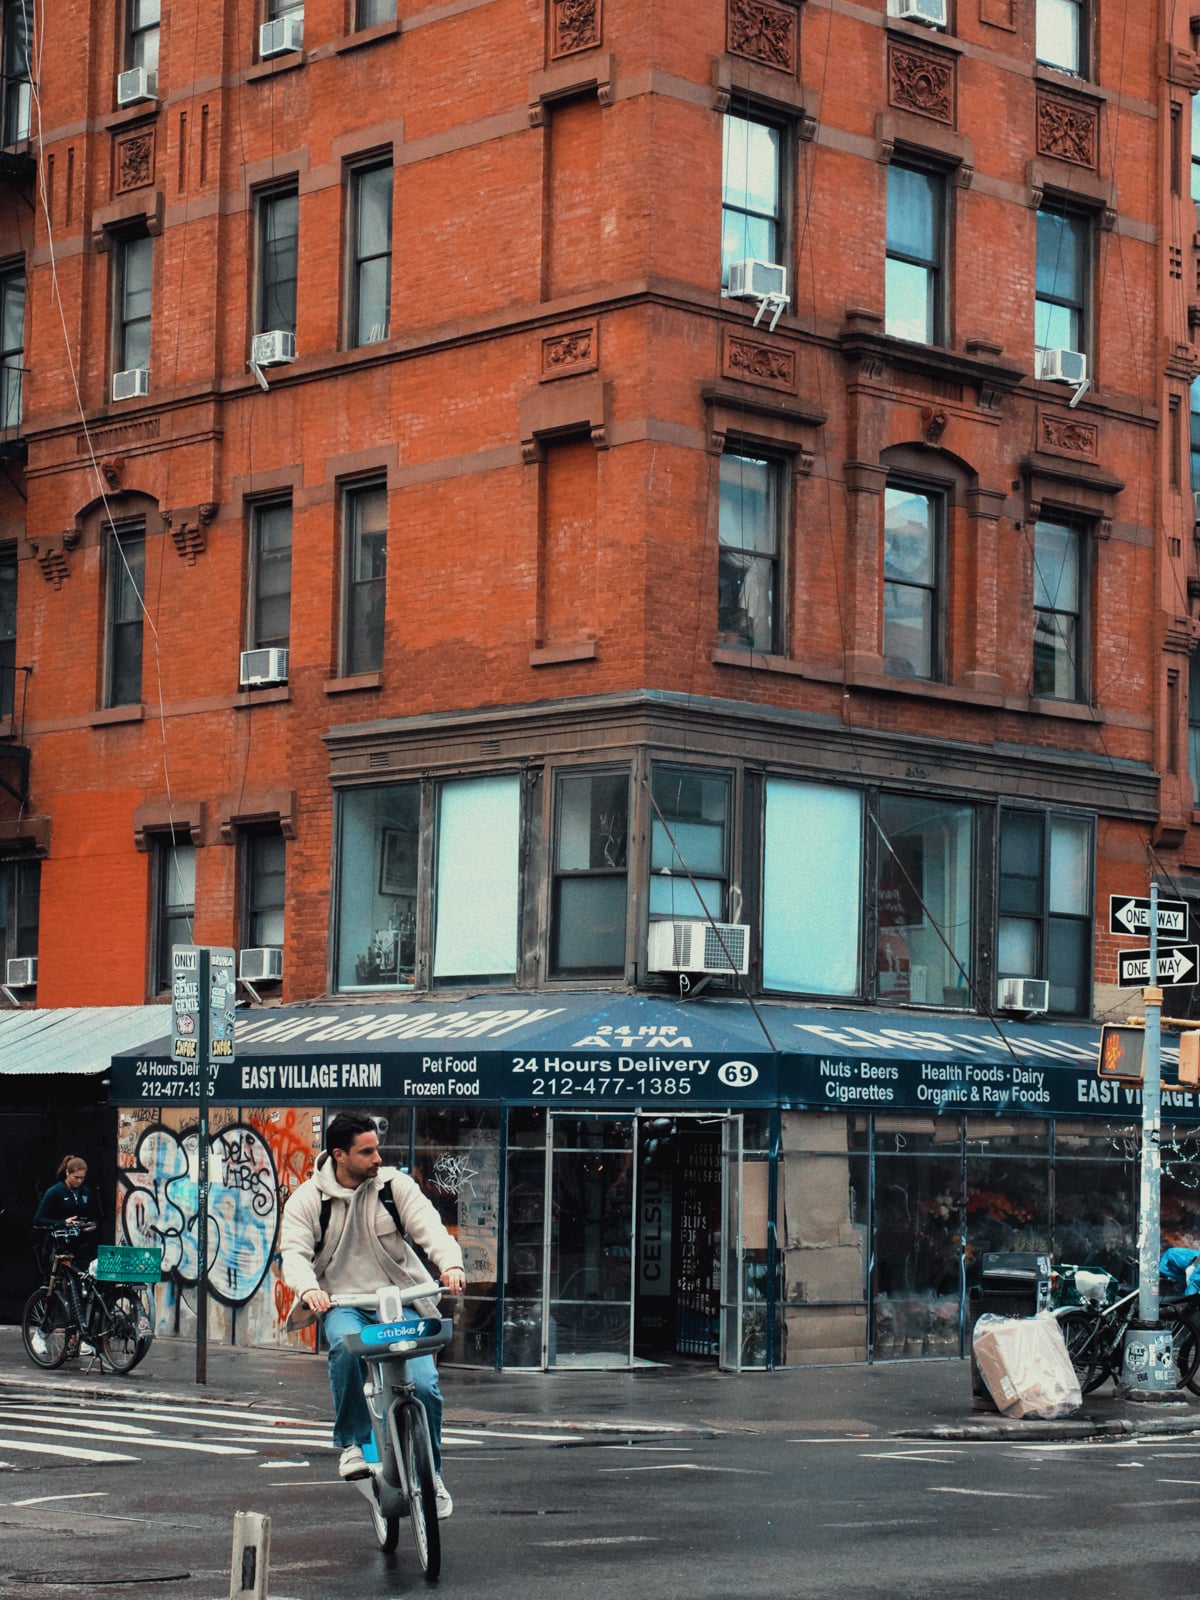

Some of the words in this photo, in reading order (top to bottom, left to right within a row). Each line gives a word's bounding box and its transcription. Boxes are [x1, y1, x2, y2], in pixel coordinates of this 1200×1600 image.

[1126, 909, 1147, 925] ONE
[1157, 911, 1179, 927] WAY
[1127, 961, 1148, 977] ONE
[1158, 958, 1182, 974] WAY
[304, 1007, 566, 1042] GROCERY
[596, 1025, 631, 1036] 24
[638, 1025, 679, 1036] HR
[571, 1036, 694, 1048] ATM
[793, 1023, 986, 1054] EAST
[136, 1061, 148, 1076] 24
[149, 1061, 178, 1076] Hours
[180, 1061, 220, 1079] Deliry
[422, 1056, 443, 1073] Pet
[445, 1056, 477, 1073] Food
[512, 1057, 538, 1073] 24
[545, 1057, 612, 1072] Hours
[618, 1057, 711, 1075] Delivery
[820, 1059, 852, 1078] Nuts
[860, 1062, 899, 1080] Beers
[242, 1066, 276, 1089] EAST
[279, 1064, 338, 1088] VILLAGE
[342, 1063, 382, 1088] FARM
[724, 1065, 753, 1083] 69
[921, 1063, 963, 1081] Health
[965, 1065, 1005, 1081] Foods
[1012, 1067, 1045, 1088] Dairy
[141, 1081, 215, 1097] 212-477-135
[404, 1079, 446, 1095] Frozen
[448, 1079, 480, 1095] Food
[532, 1078, 692, 1095] 212-477-1385
[825, 1081, 894, 1102] Cigarettes
[917, 1084, 968, 1105] Organic
[970, 1085, 980, 1101] &
[982, 1086, 1010, 1102] Raw
[1011, 1086, 1051, 1103] Foods
[1078, 1079, 1120, 1105] EAST
[1125, 1088, 1194, 1107] VIAGE
